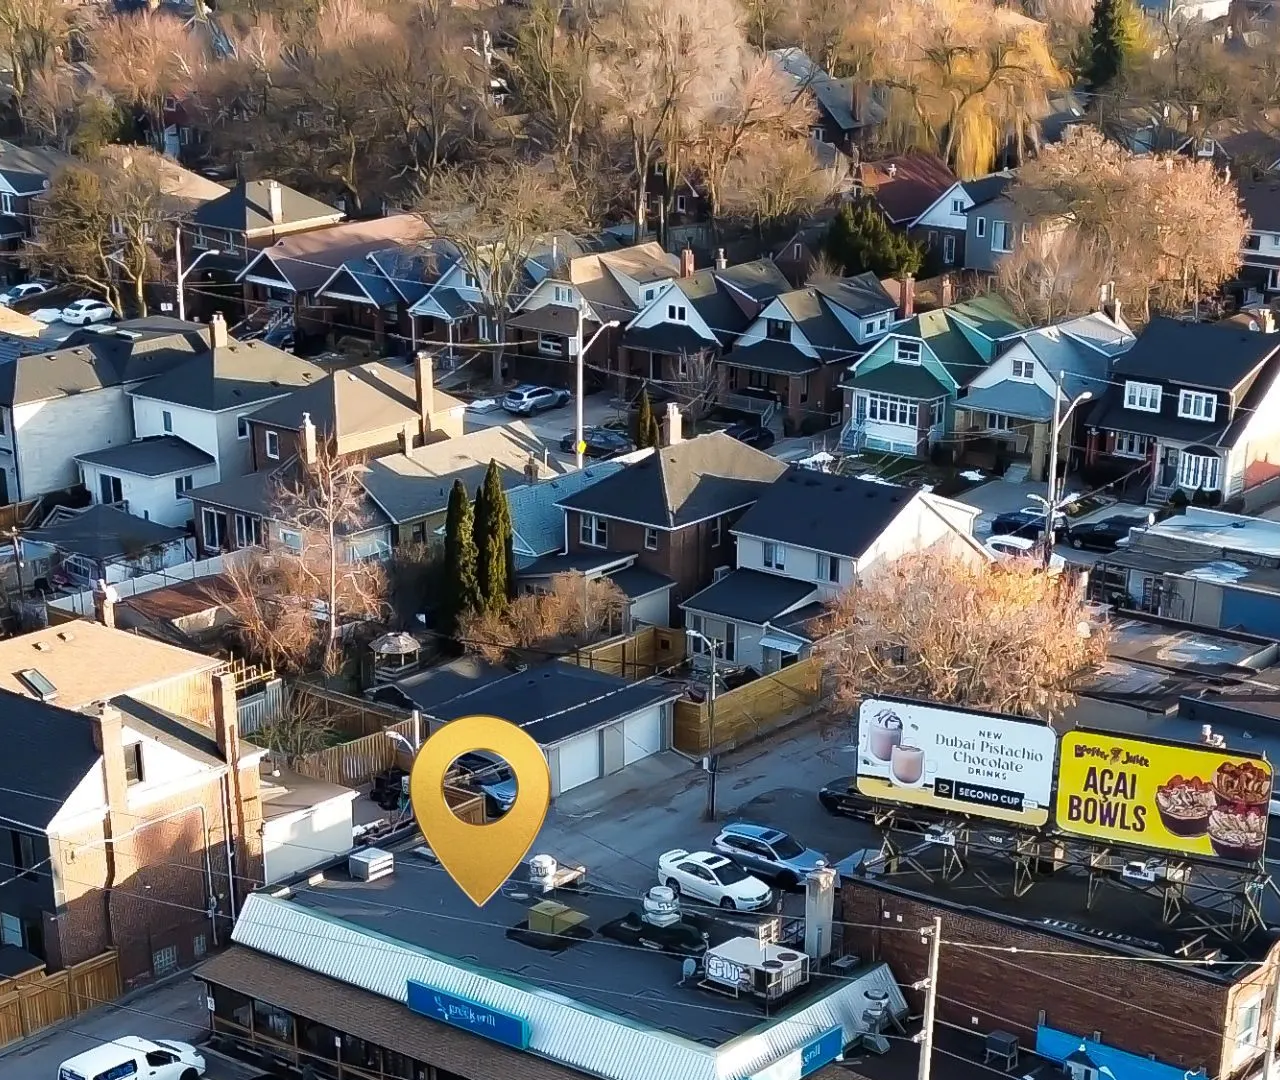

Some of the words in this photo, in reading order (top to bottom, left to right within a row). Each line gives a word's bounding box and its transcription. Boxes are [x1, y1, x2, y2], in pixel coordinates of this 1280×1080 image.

[979, 730, 1002, 740] NEW
[935, 734, 975, 750] Dubai
[981, 740, 1043, 762] Pistachio
[953, 751, 1024, 772] Chocolate
[968, 767, 1007, 780] DRINKS
[1083, 766, 1137, 803] AÇAI
[959, 787, 999, 802] SECOND
[1000, 795, 1020, 806] CUP
[1067, 795, 1147, 832] BOWLS
